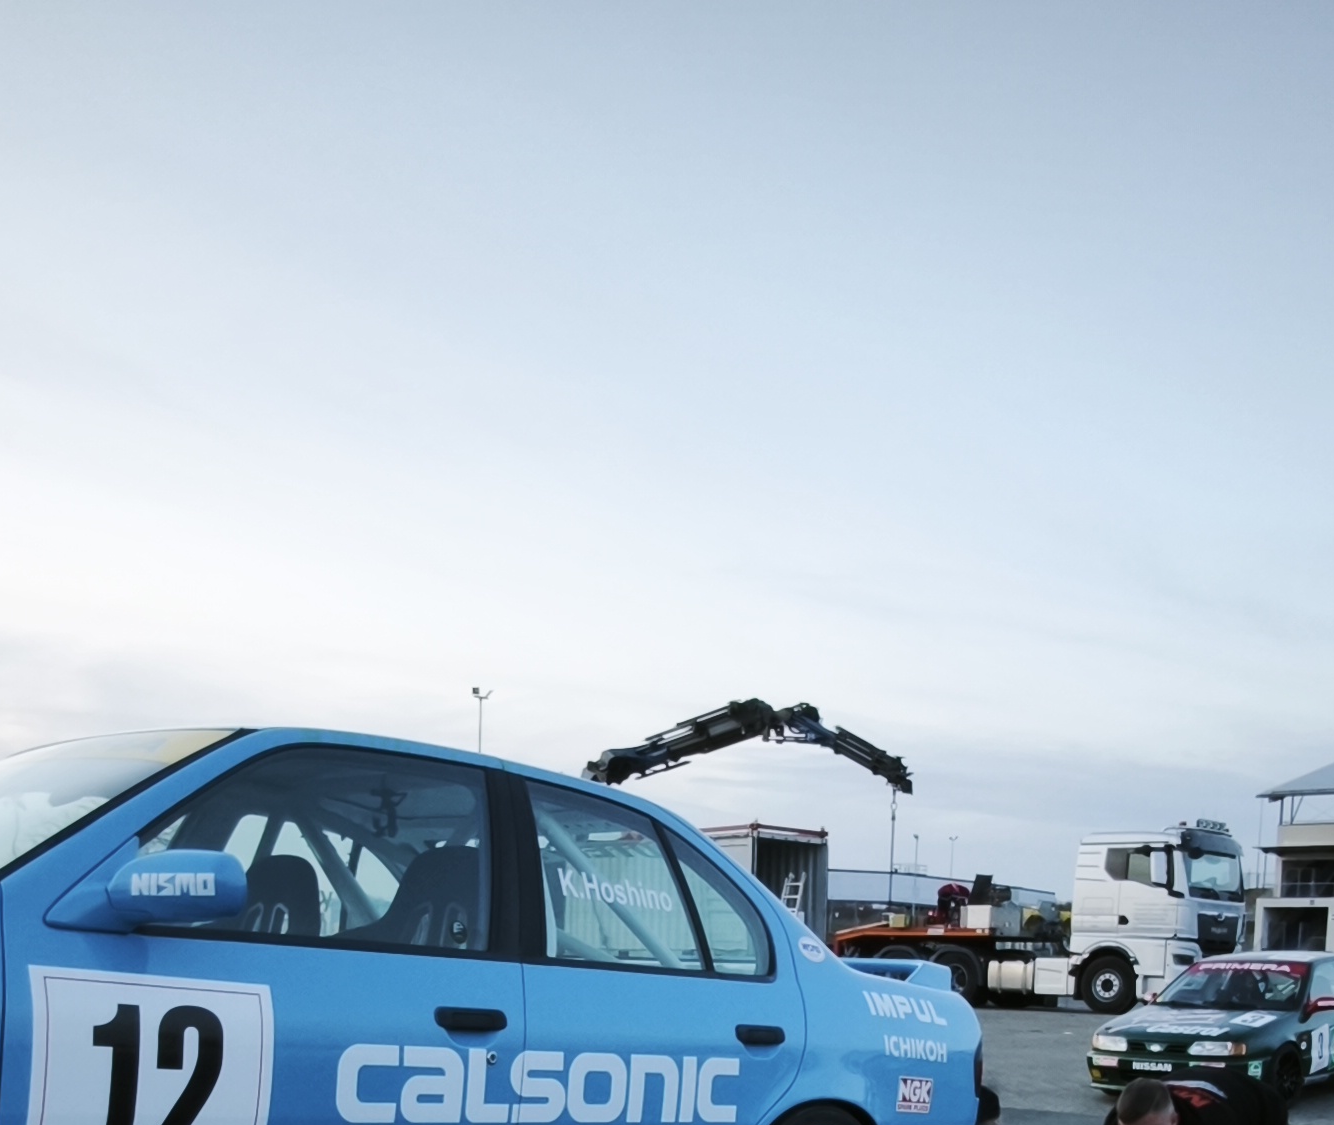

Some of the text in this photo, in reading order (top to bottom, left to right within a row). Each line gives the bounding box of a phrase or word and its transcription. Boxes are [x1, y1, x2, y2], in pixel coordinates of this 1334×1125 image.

[131, 872, 215, 896] NISMO
[557, 868, 673, 912] K.Hoshino
[1199, 963, 1290, 972] PRIMERA
[862, 990, 948, 1026] IMPUL
[883, 1034, 947, 1063] ICHIKOH
[1132, 1061, 1172, 1072] NISSAN
[898, 1079, 932, 1103] NGK
